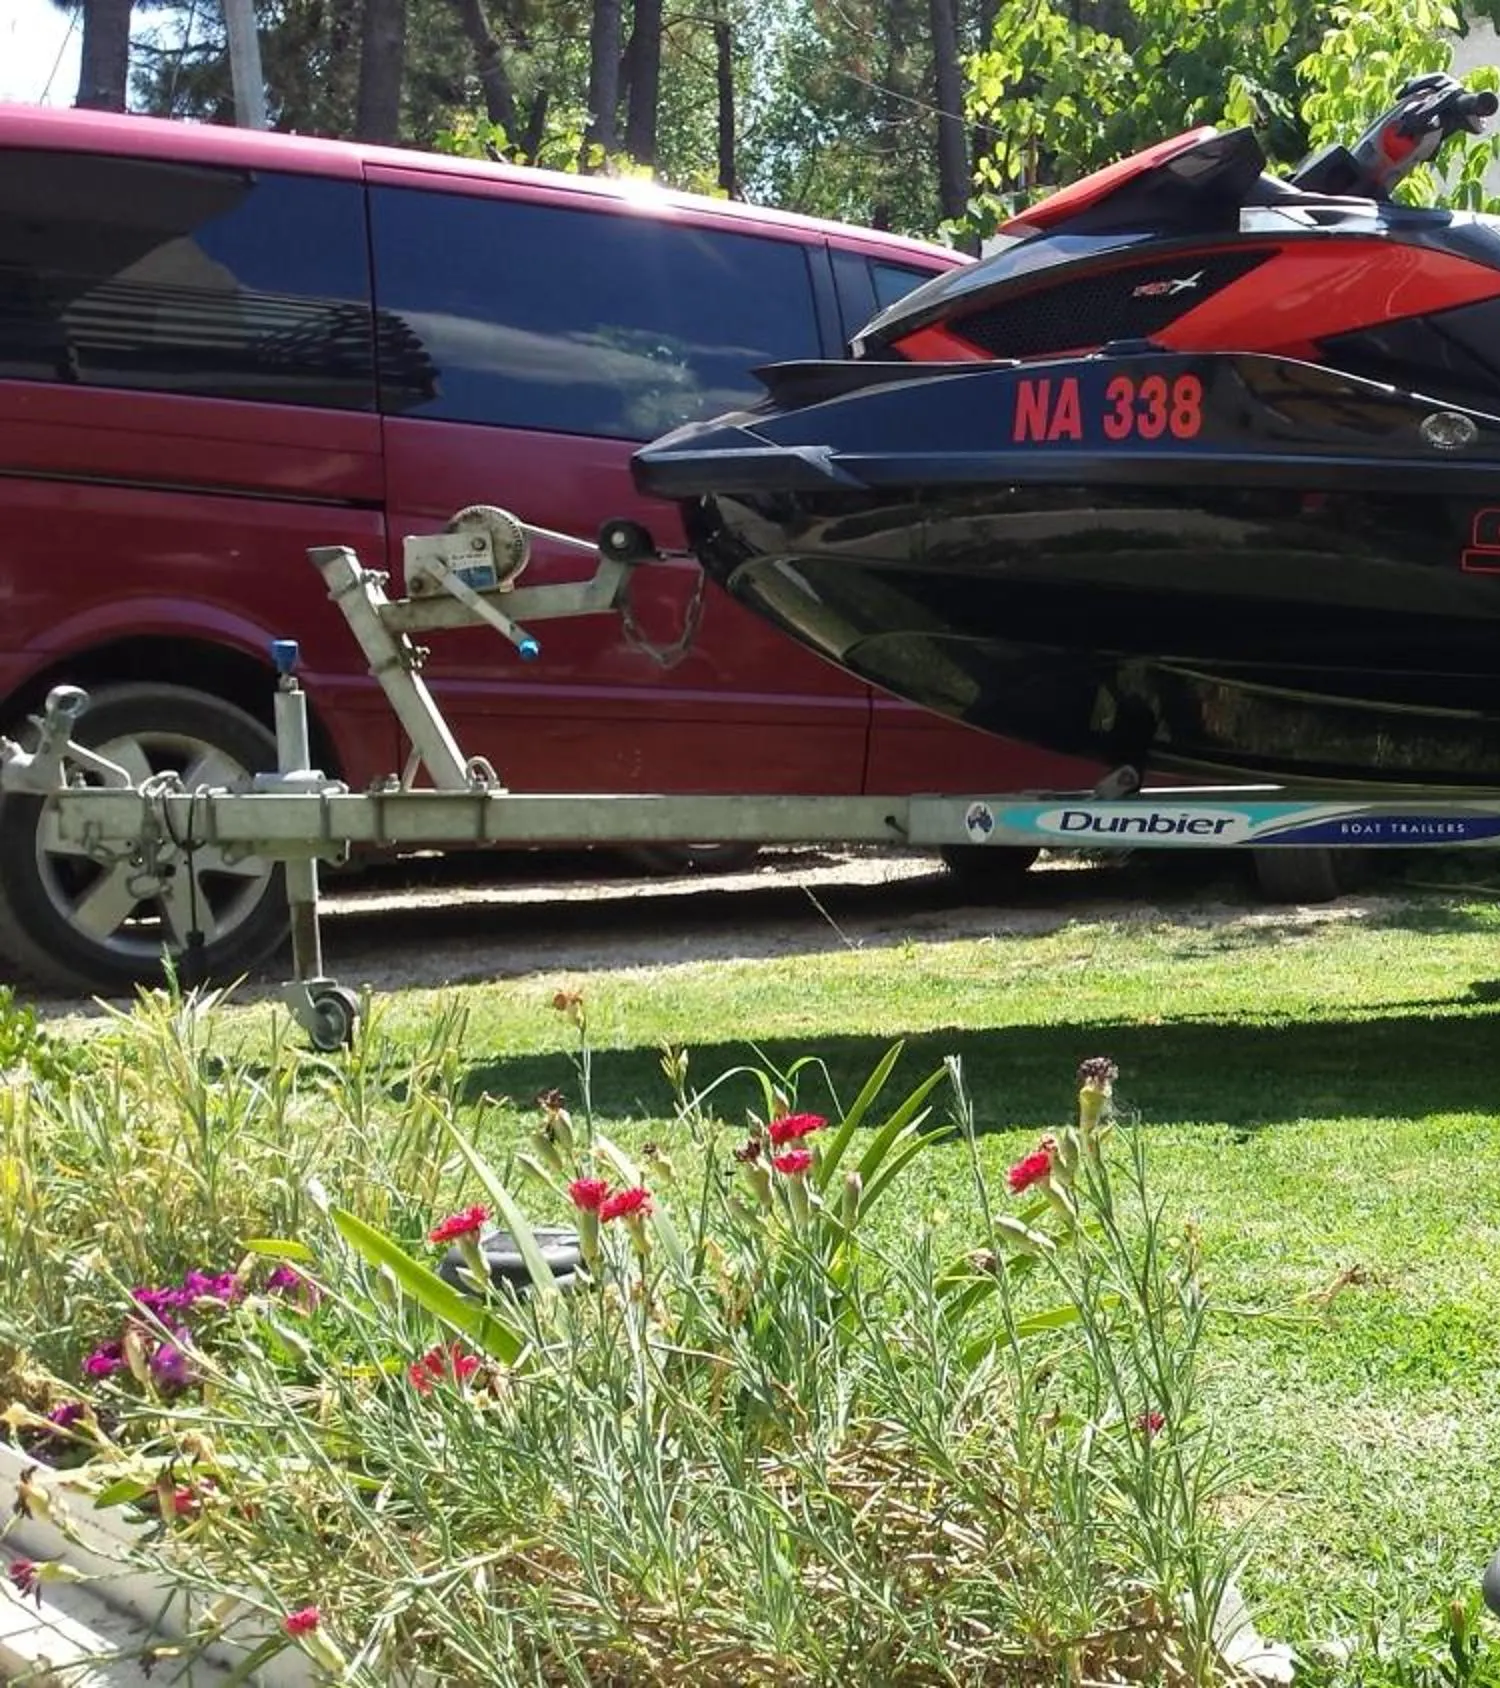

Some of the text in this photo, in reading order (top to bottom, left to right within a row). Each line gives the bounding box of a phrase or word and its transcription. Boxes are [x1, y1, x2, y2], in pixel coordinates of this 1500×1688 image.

[1013, 375, 1201, 441] NA 338
[1060, 811, 1235, 834] Dunbier
[1341, 823, 1465, 833] BOAT TRAILERS
